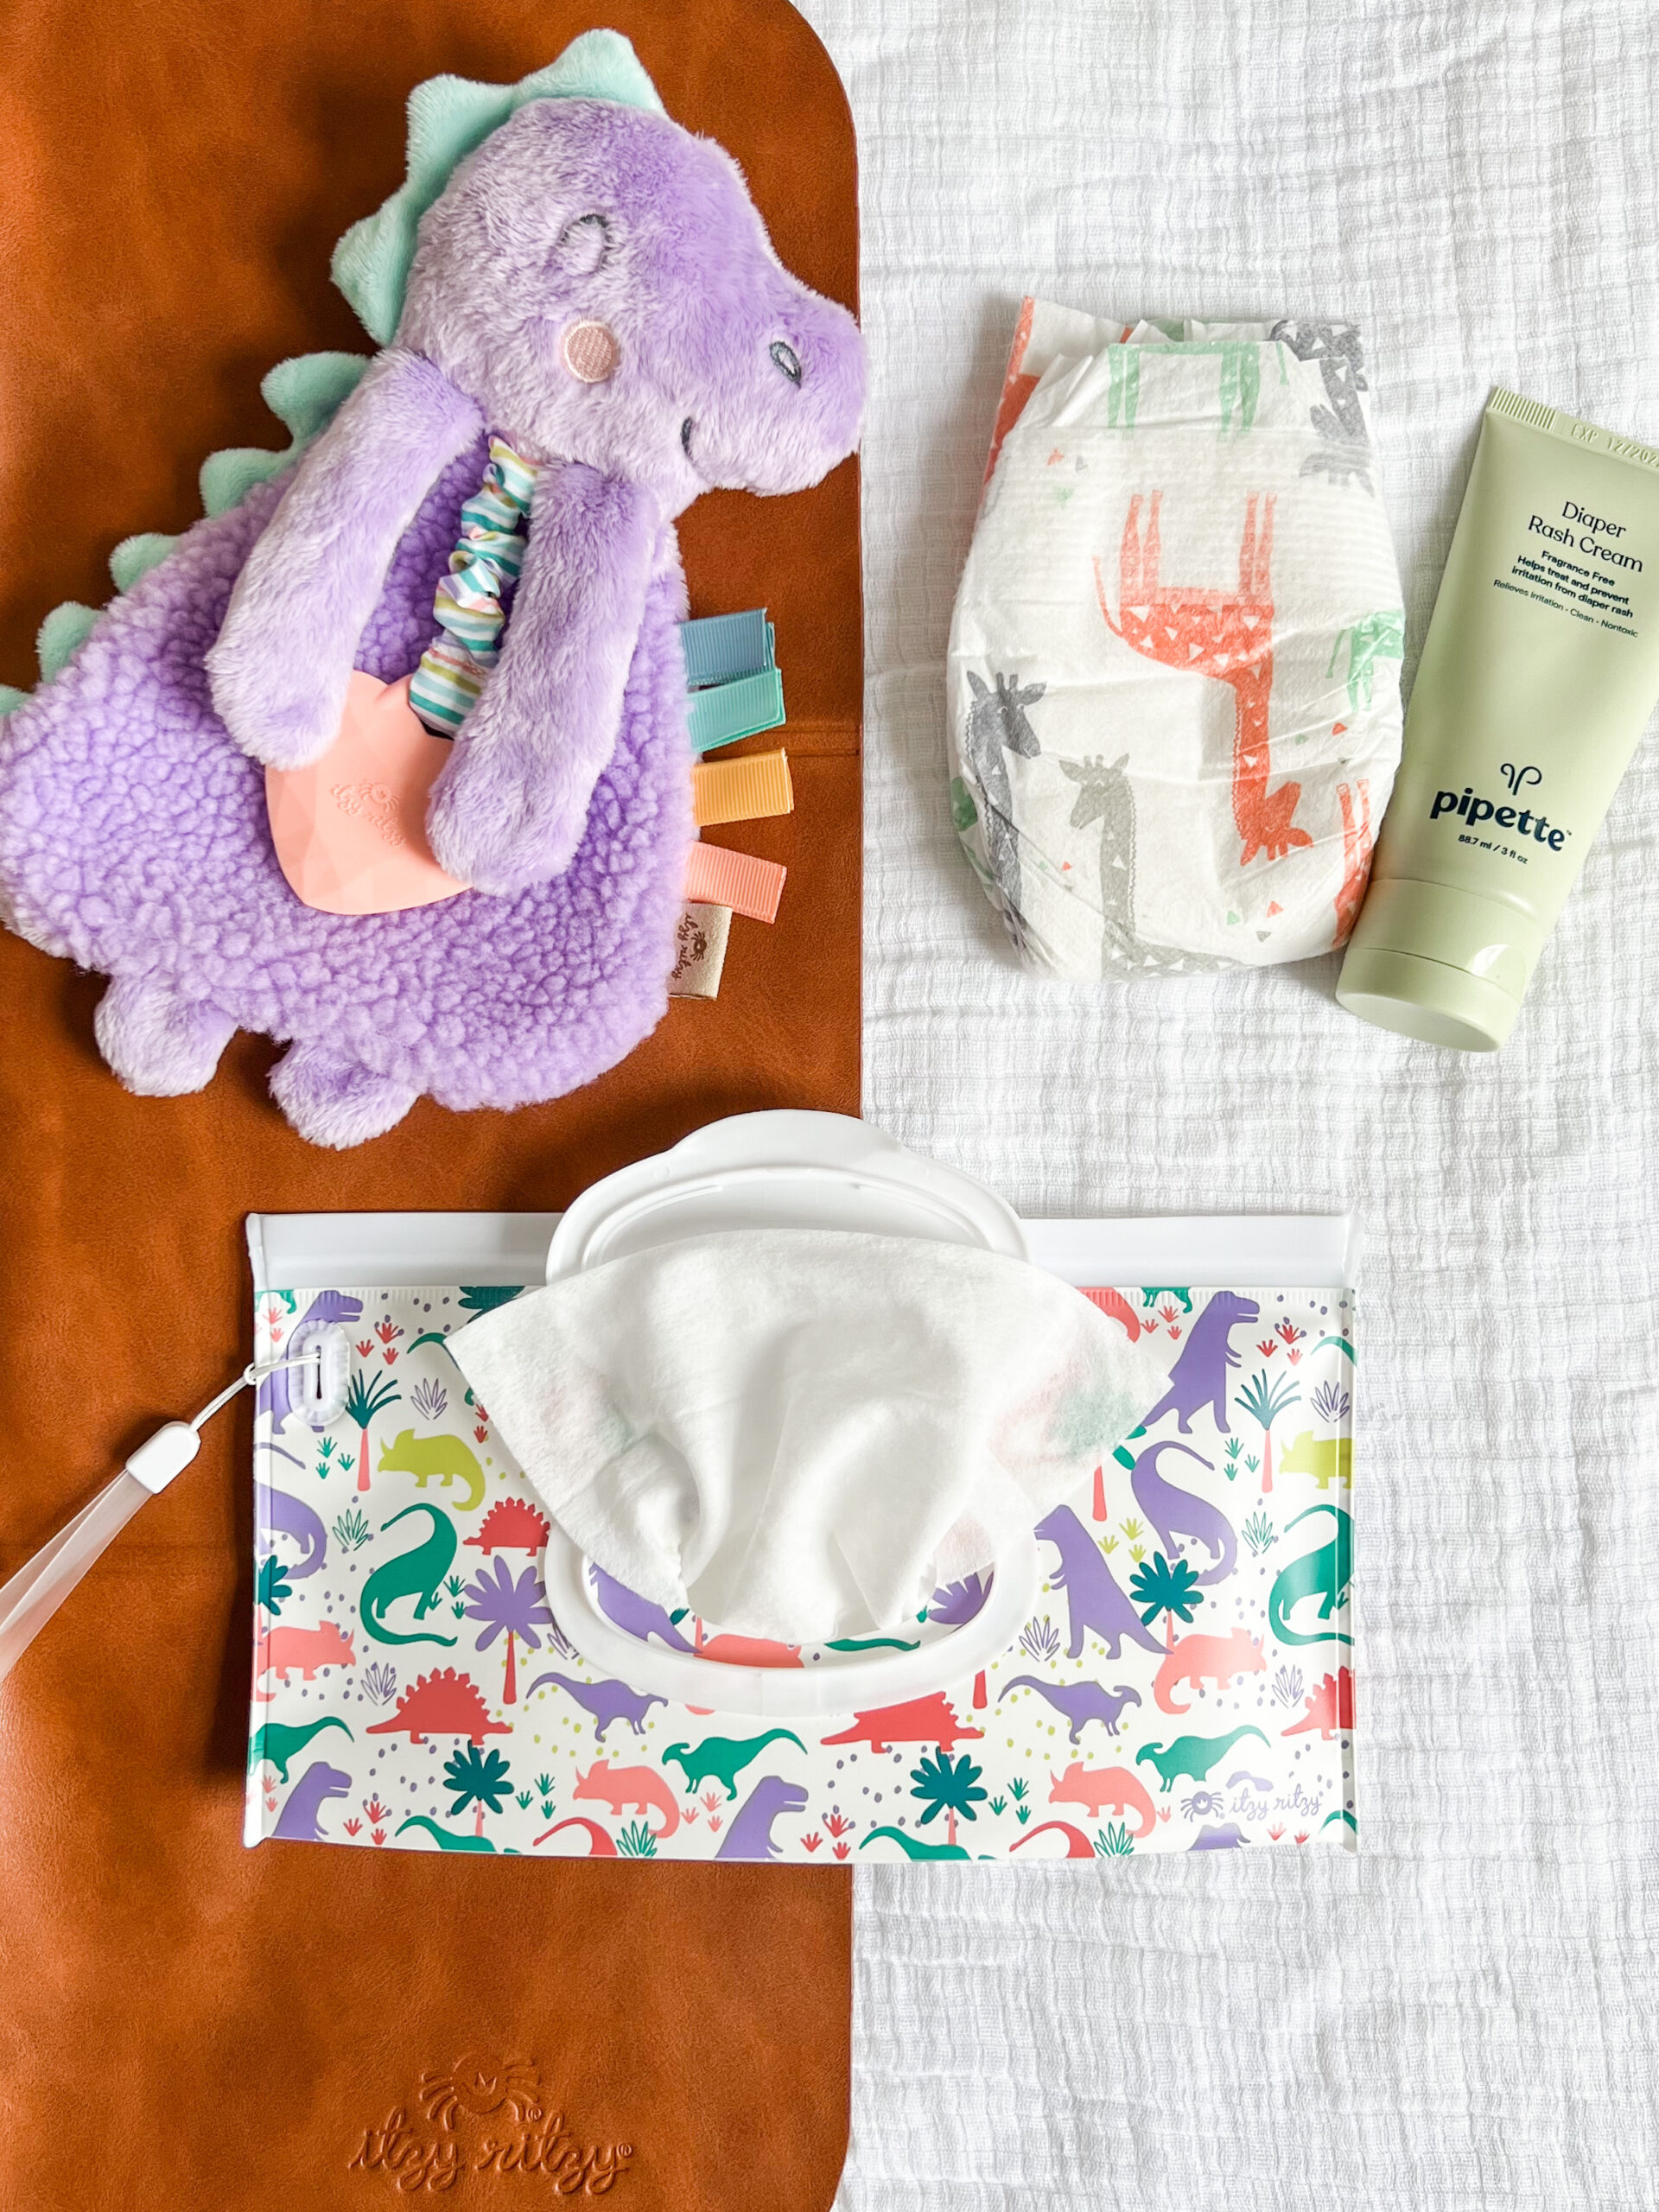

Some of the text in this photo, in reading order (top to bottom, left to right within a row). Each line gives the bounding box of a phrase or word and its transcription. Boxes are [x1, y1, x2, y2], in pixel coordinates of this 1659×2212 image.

[1607, 436, 1659, 467] 12/202
[1561, 501, 1627, 538] Diaper
[1528, 515, 1643, 573] Rash Cream
[1517, 555, 1630, 606] Helps treat and prevent
[1541, 550, 1616, 587] Fragrance Free
[1493, 579, 1529, 597] Relieves
[1570, 607, 1594, 623] Clean
[1600, 620, 1638, 638] Nontoxic
[1511, 565, 1634, 619] irritation from diaper rash
[1458, 834, 1478, 845] 88.7
[1479, 841, 1491, 850] ml
[1501, 847, 1508, 855] 3
[1510, 849, 1516, 859] fl
[1517, 855, 1528, 864] oz
[1230, 1783, 1323, 1821] itzy ritzy
[348, 2106, 466, 2191] itzy
